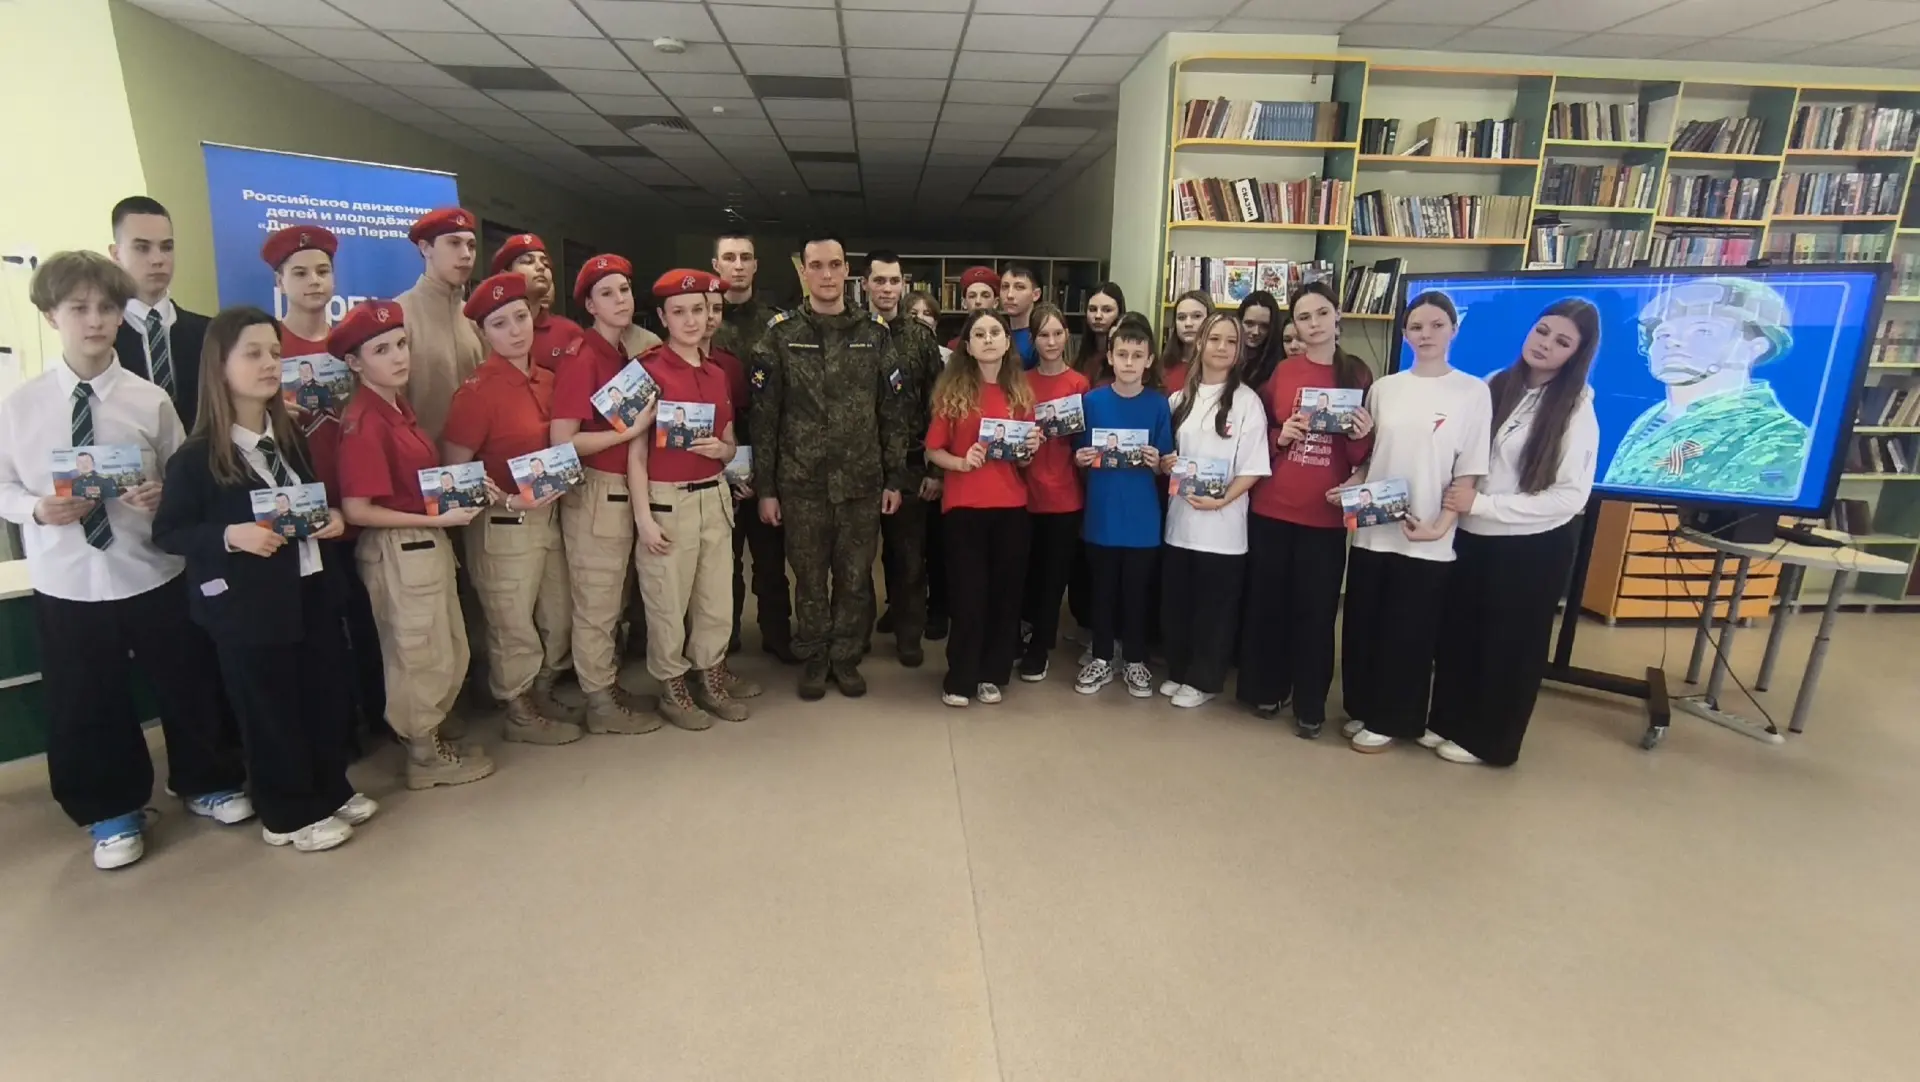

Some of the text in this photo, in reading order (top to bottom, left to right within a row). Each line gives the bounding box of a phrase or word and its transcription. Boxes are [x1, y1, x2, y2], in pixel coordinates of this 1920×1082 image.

[242, 189, 433, 215] Российское движение
[1241, 187, 1254, 217] СКАЗКИ
[265, 208, 420, 226] детей и молодёжи
[358, 226, 410, 239] Первы
